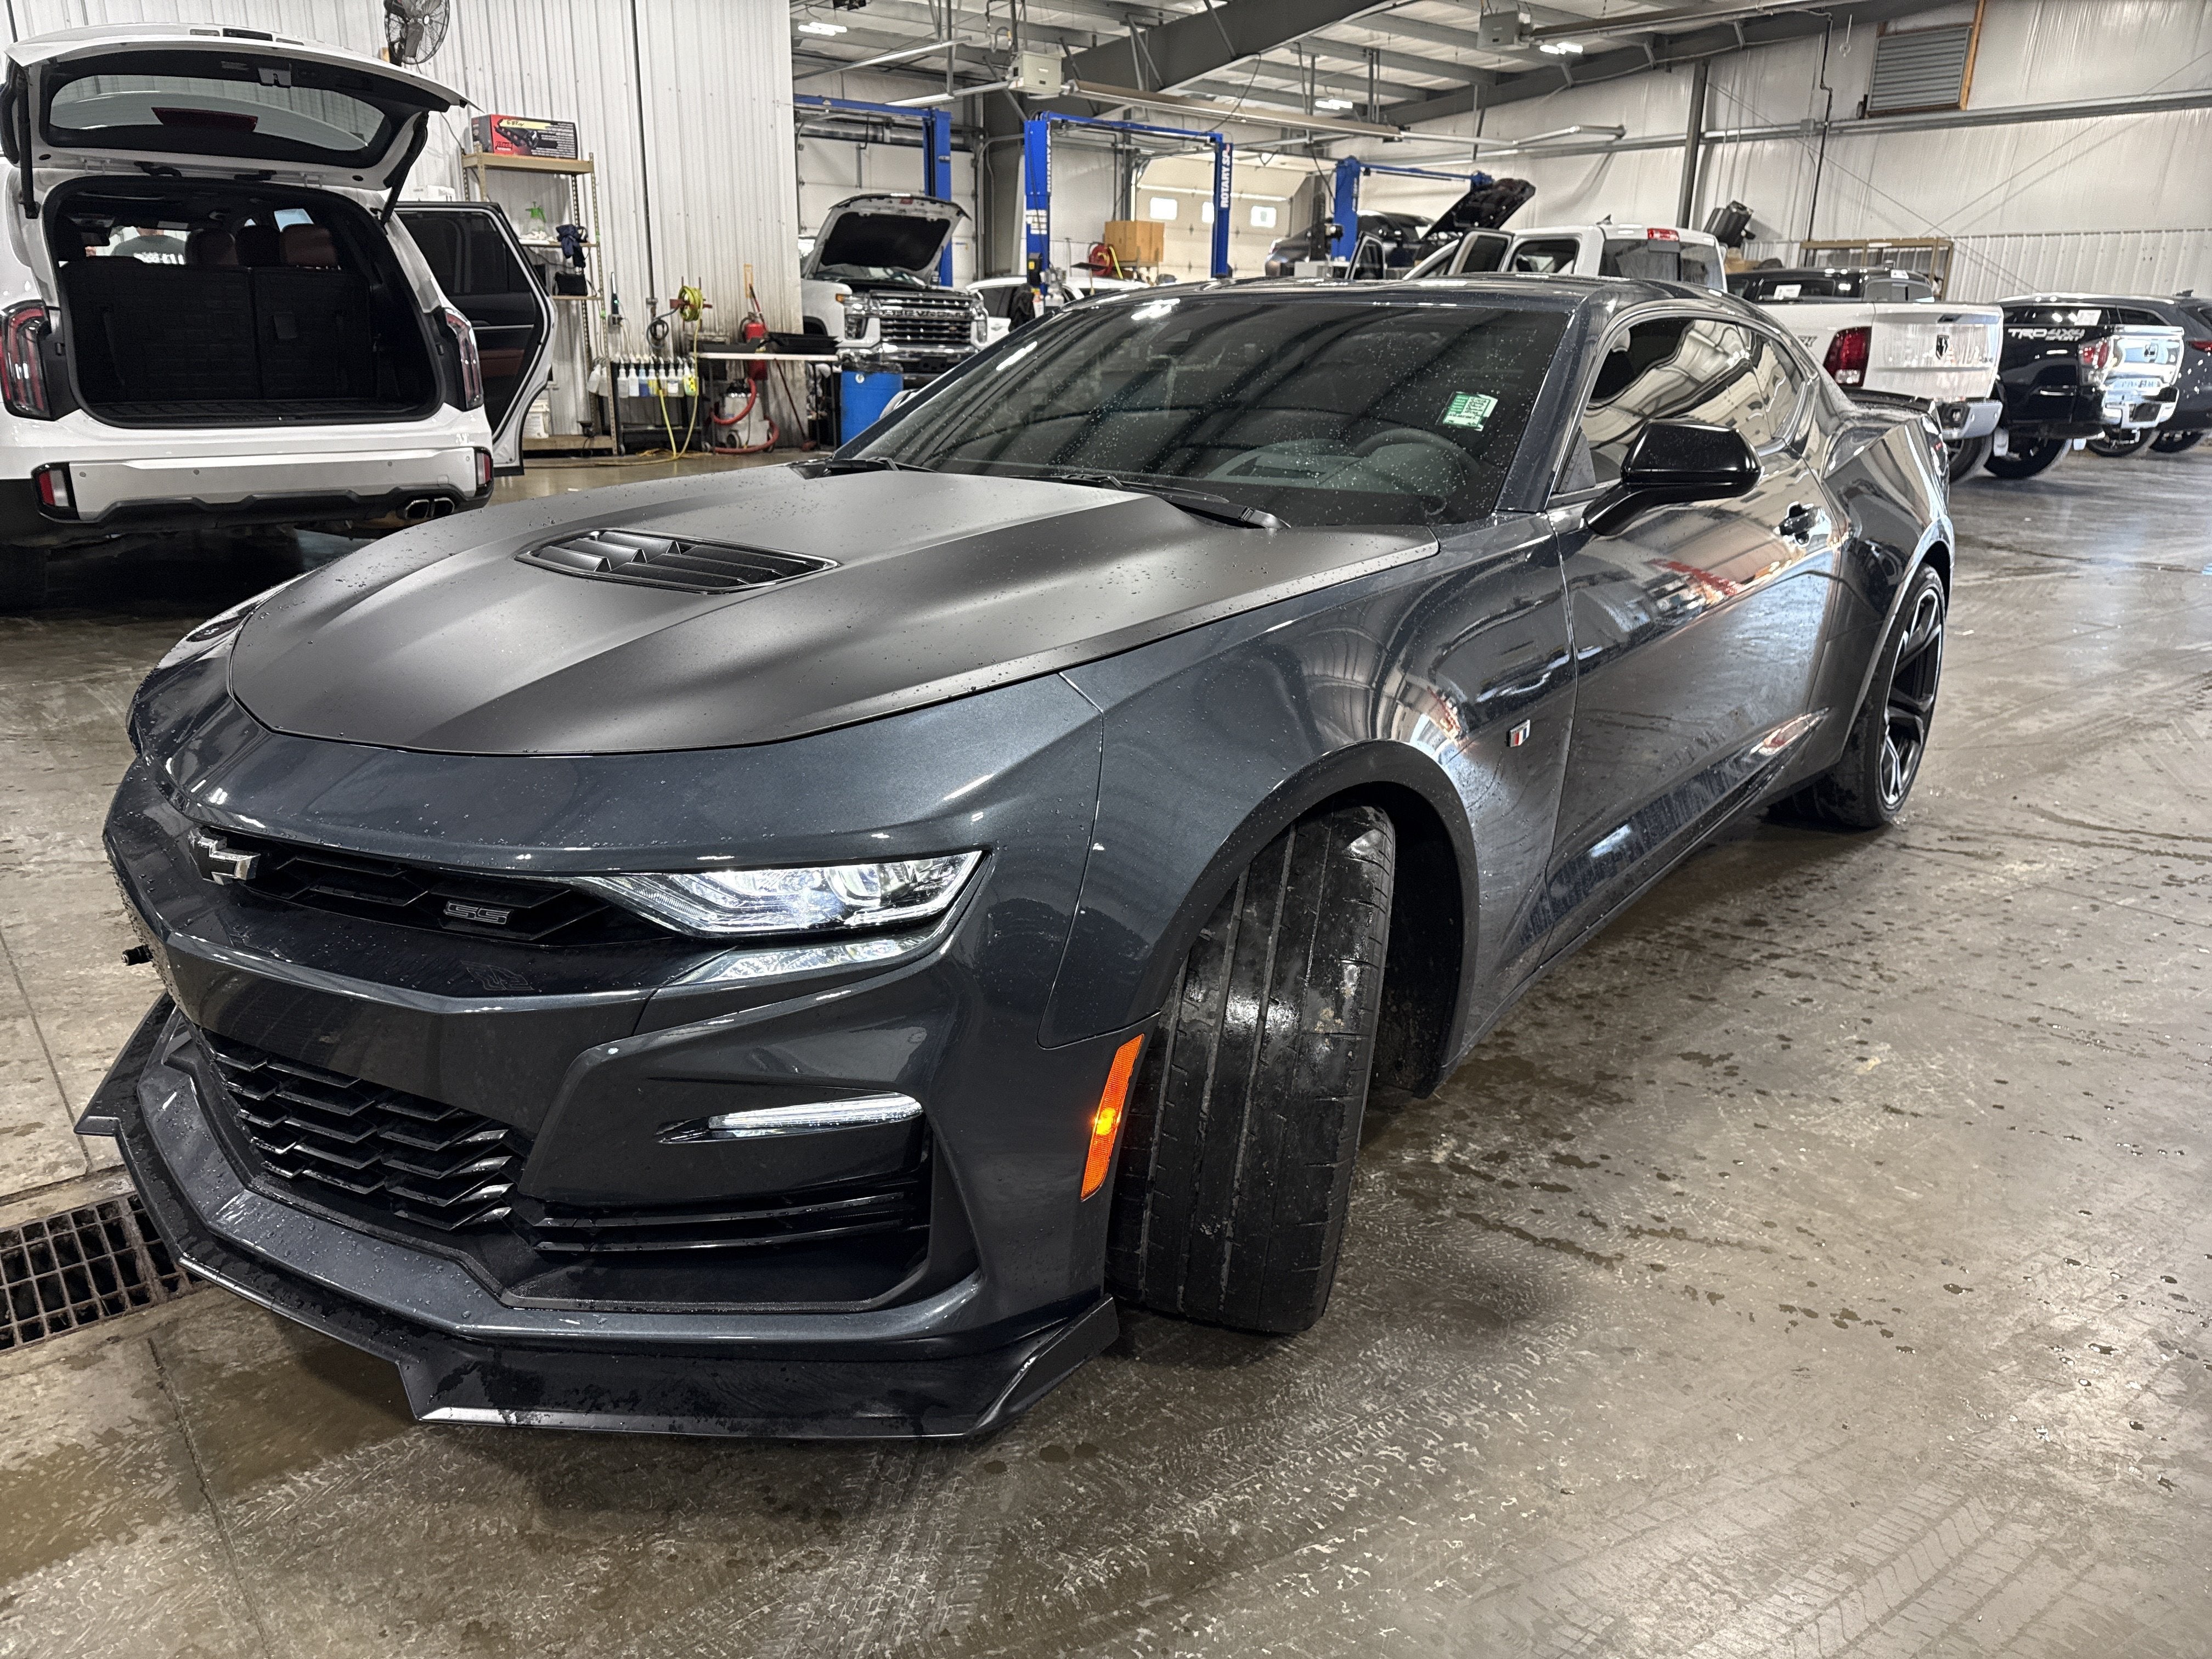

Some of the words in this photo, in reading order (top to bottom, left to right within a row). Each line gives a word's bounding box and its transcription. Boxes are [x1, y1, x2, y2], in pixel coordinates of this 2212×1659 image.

[1220, 166, 1229, 208] ROTARY
[2008, 328, 2047, 339] TRD
[443, 900, 512, 925] SS
